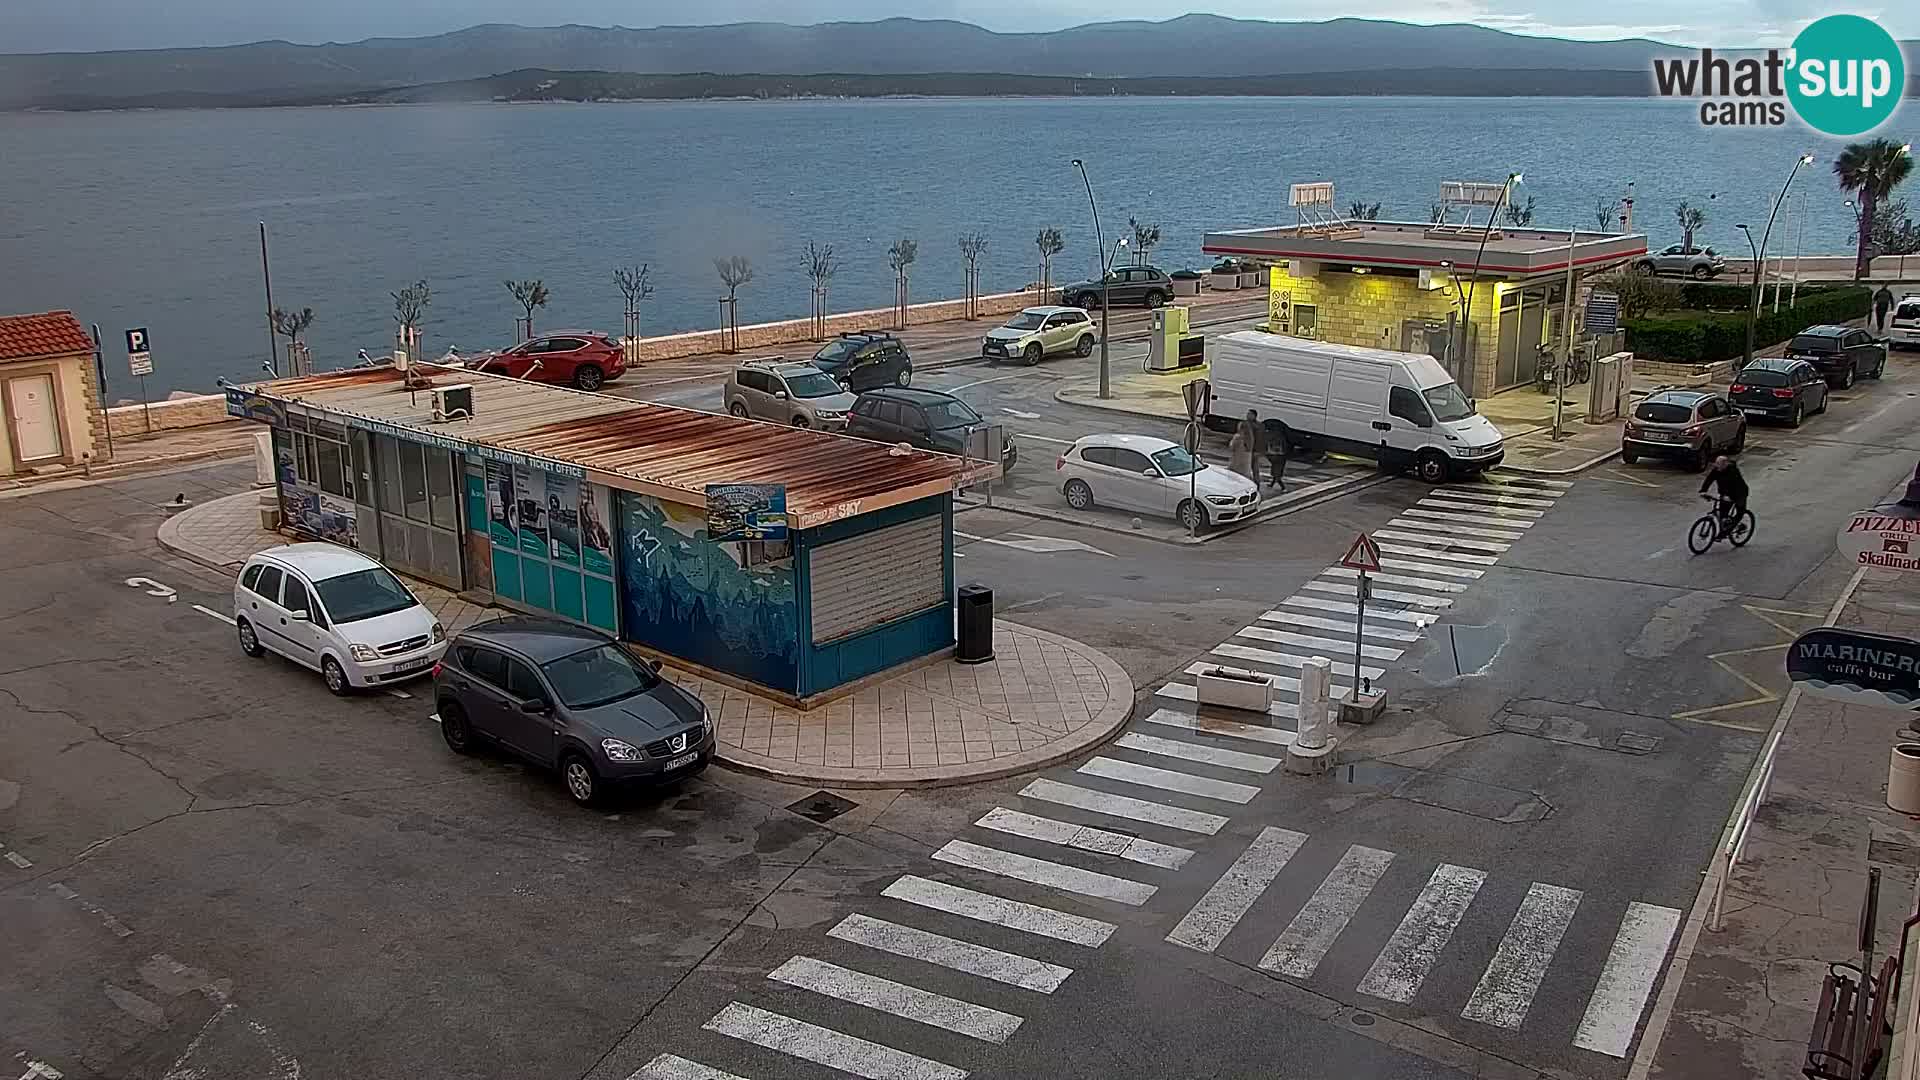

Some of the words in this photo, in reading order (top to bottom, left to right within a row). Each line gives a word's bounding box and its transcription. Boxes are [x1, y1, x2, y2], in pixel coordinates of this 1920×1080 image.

[131, 331, 144, 350] P
[478, 447, 494, 459] BUS
[494, 450, 527, 465] STATION
[528, 457, 555, 472] TICKET
[555, 463, 583, 477] OFFICE
[1880, 531, 1917, 542] GRILL
[1827, 663, 1864, 676] caffe
[1868, 666, 1896, 681] bar
